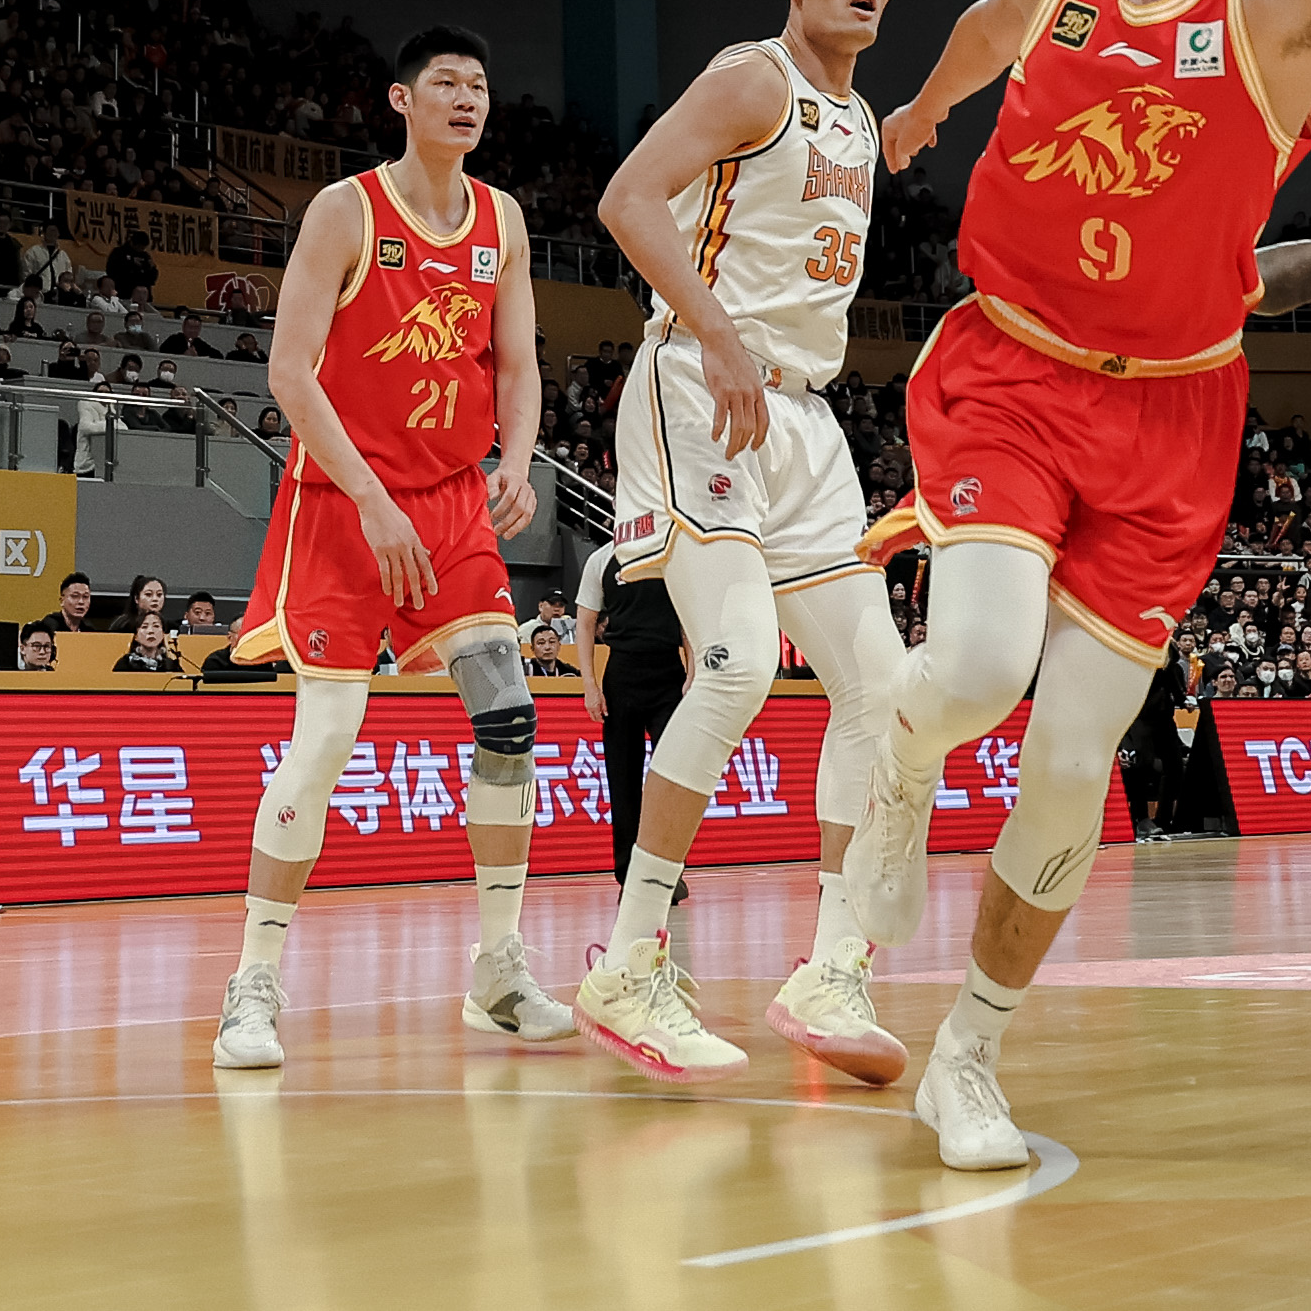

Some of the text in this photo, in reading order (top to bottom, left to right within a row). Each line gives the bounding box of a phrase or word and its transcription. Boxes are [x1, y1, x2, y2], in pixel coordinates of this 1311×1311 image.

[801, 138, 869, 220] SHANXI
[805, 226, 861, 286] 35
[1078, 217, 1132, 281] 9
[406, 378, 458, 429] 21
[18, 746, 202, 847] 华星
